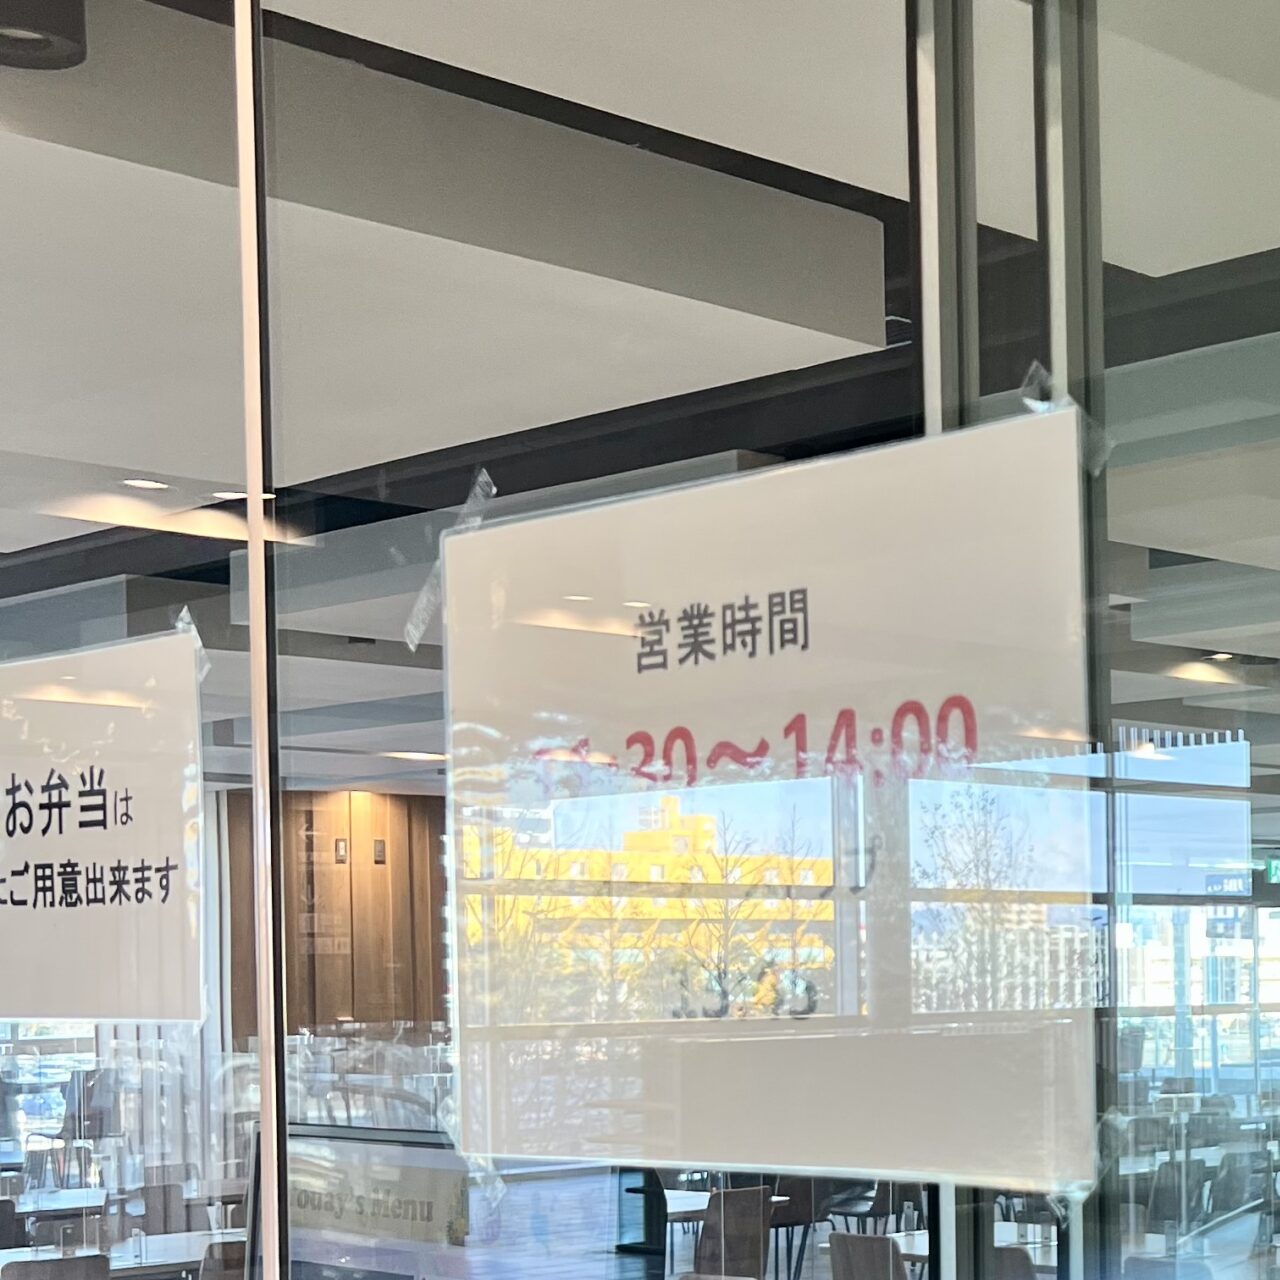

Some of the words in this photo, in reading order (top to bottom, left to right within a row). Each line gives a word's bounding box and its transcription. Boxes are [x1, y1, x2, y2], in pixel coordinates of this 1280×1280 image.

[635, 587, 811, 674] 営業時間
[5, 764, 134, 837] お弁当は
[0, 856, 179, 909] ご用意出来ます
